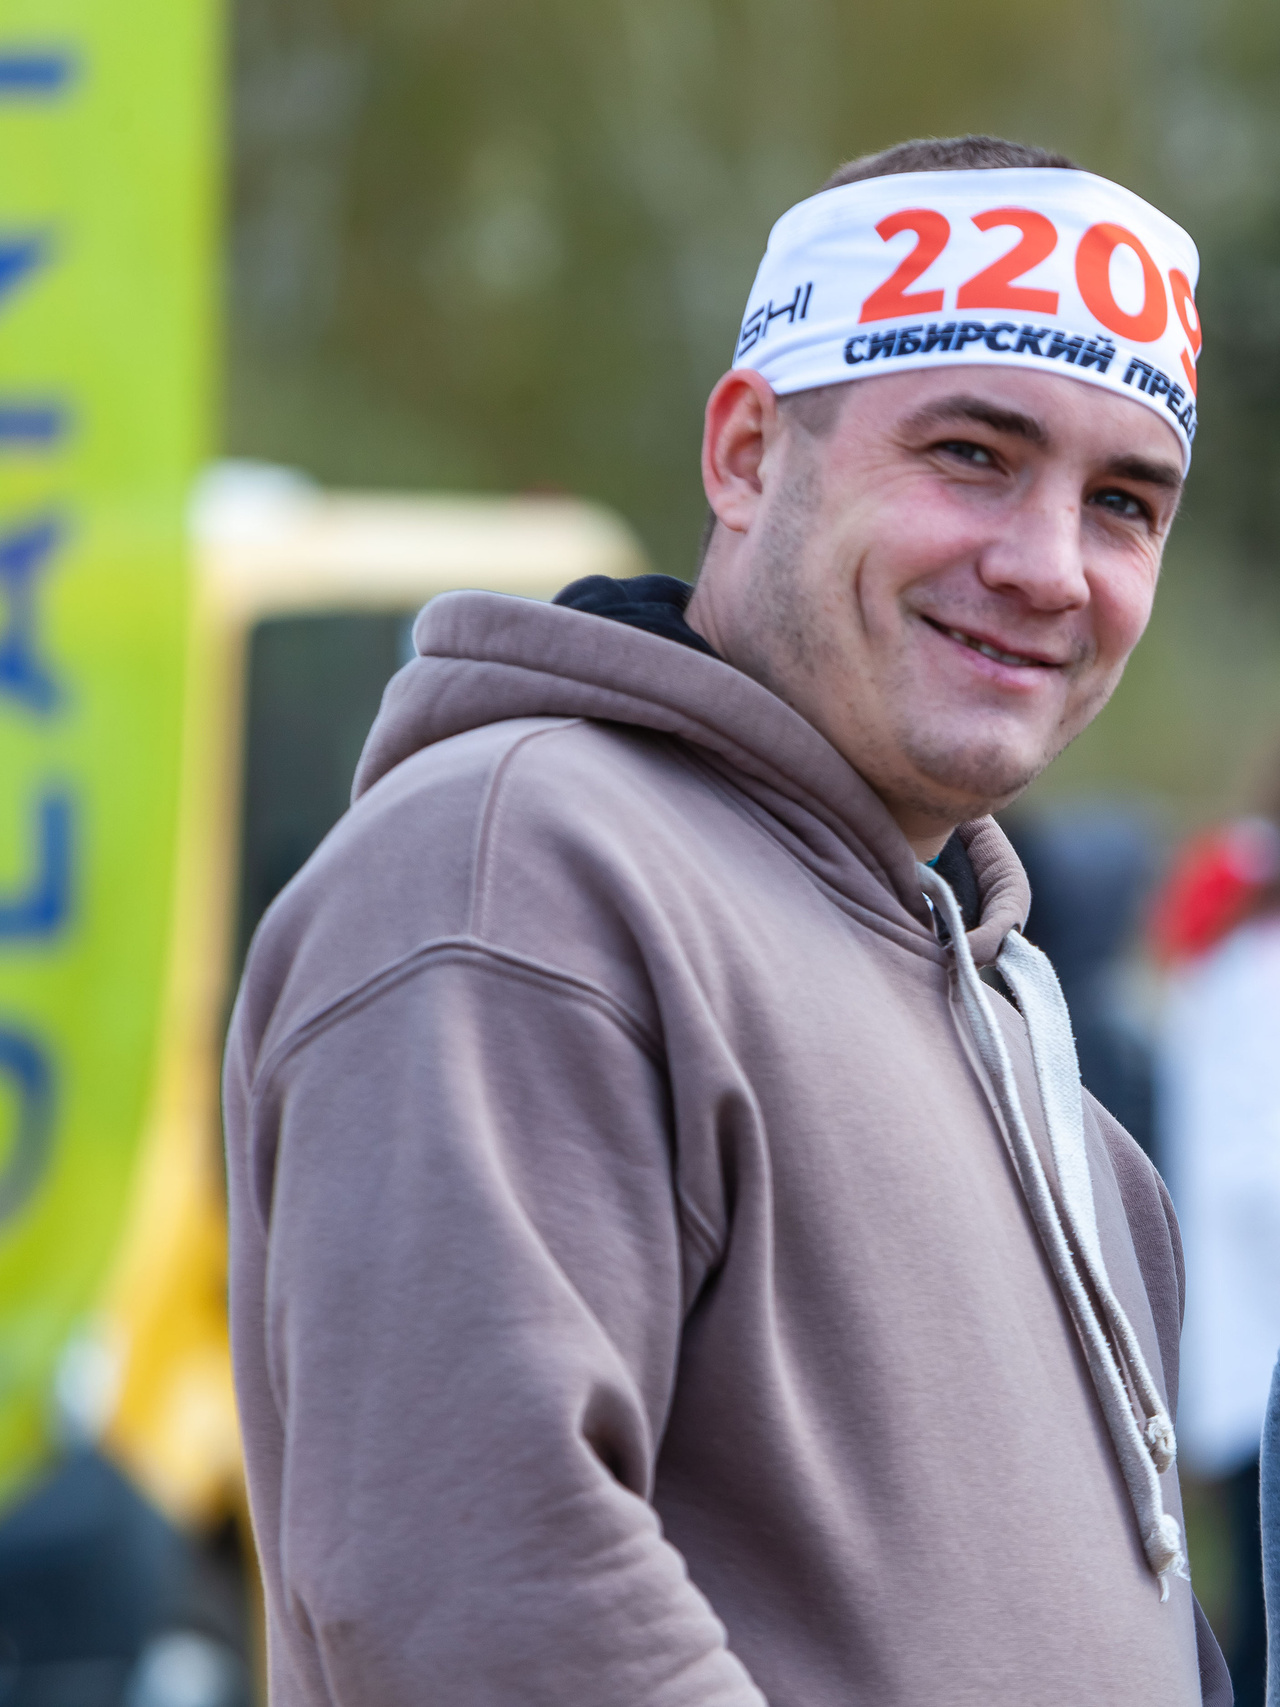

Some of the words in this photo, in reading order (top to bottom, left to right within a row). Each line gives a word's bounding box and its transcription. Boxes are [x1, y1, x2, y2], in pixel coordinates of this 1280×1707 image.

[734, 281, 813, 364] SHI
[844, 320, 1116, 374] СИБИРСКИЙ
[1122, 357, 1198, 445] ПРЕД
